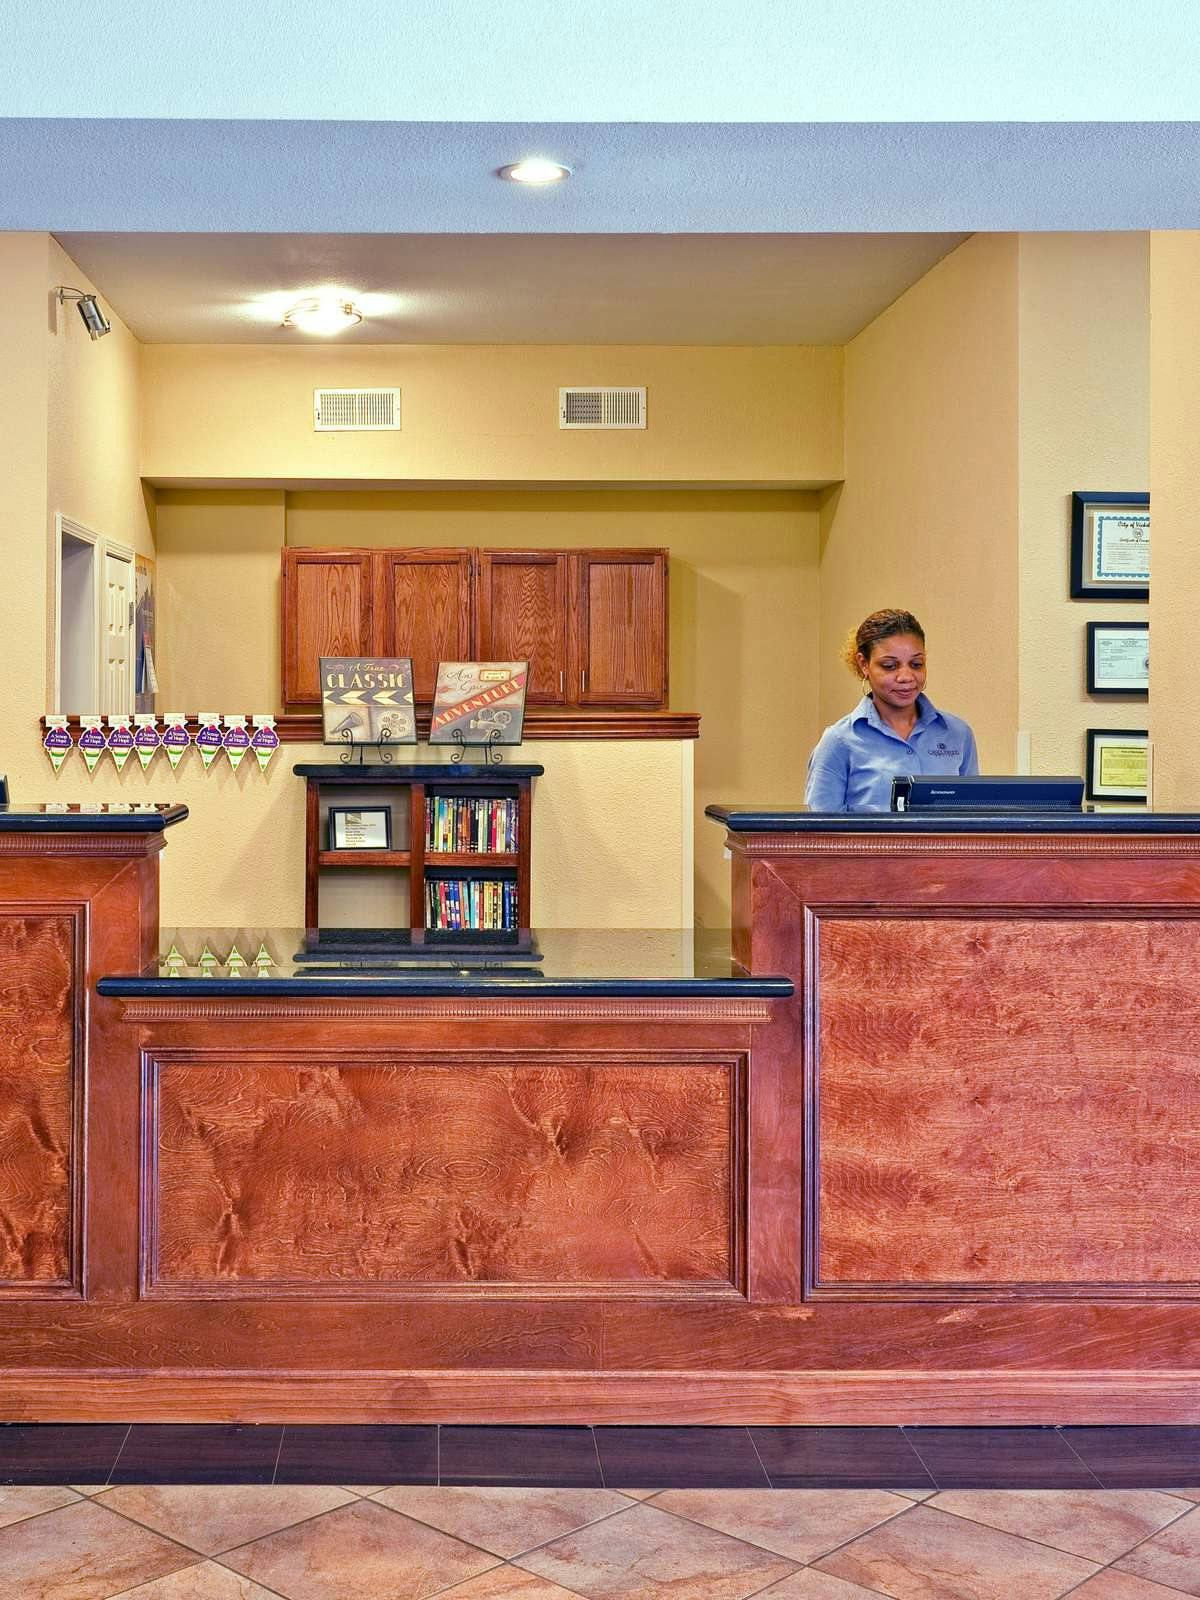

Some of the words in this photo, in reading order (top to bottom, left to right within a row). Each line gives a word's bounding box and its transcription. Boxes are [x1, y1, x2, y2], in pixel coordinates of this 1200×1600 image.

[350, 662, 360, 672] A
[363, 663, 385, 672] True
[326, 673, 408, 688] CLASSIC
[434, 680, 520, 726] ADVENTURE
